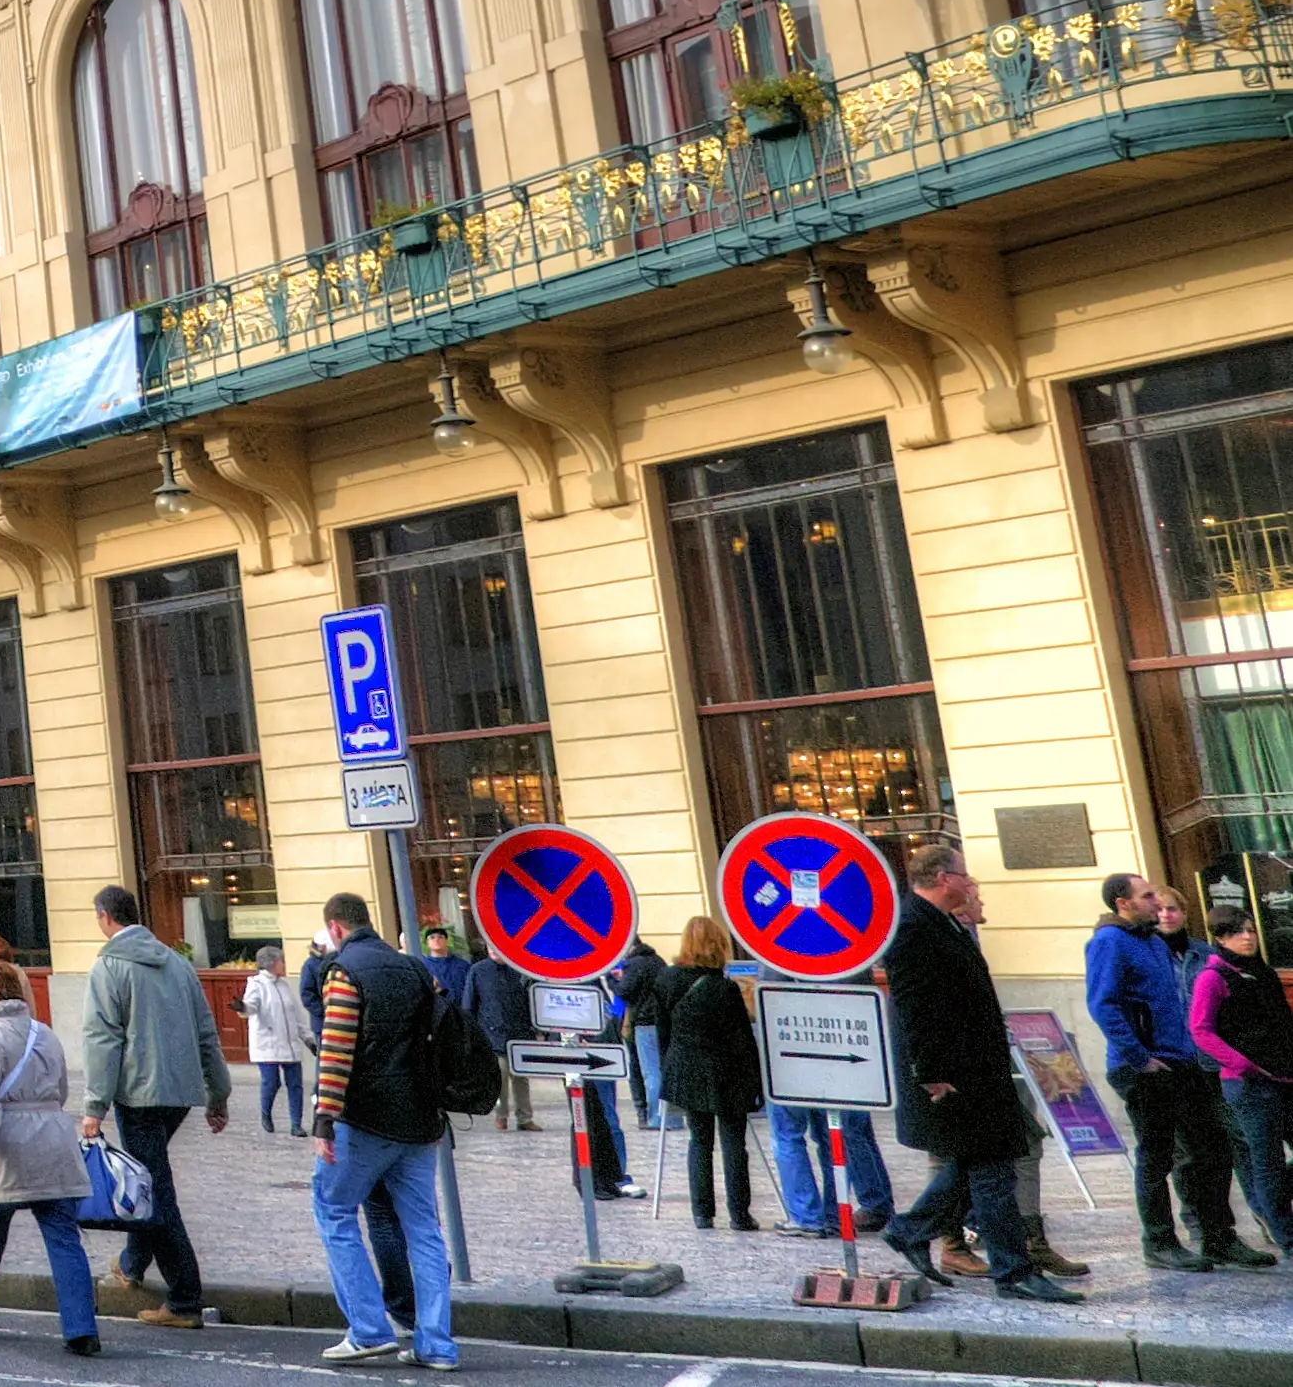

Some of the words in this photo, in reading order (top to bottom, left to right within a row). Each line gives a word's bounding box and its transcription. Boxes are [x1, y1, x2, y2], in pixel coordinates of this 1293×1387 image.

[336, 630, 377, 714] P
[350, 787, 359, 809] 3
[776, 1016, 789, 1027] od
[793, 1016, 841, 1030] 1.11.2011
[778, 1030, 791, 1041] do
[794, 1030, 843, 1045] 3.11.2011
